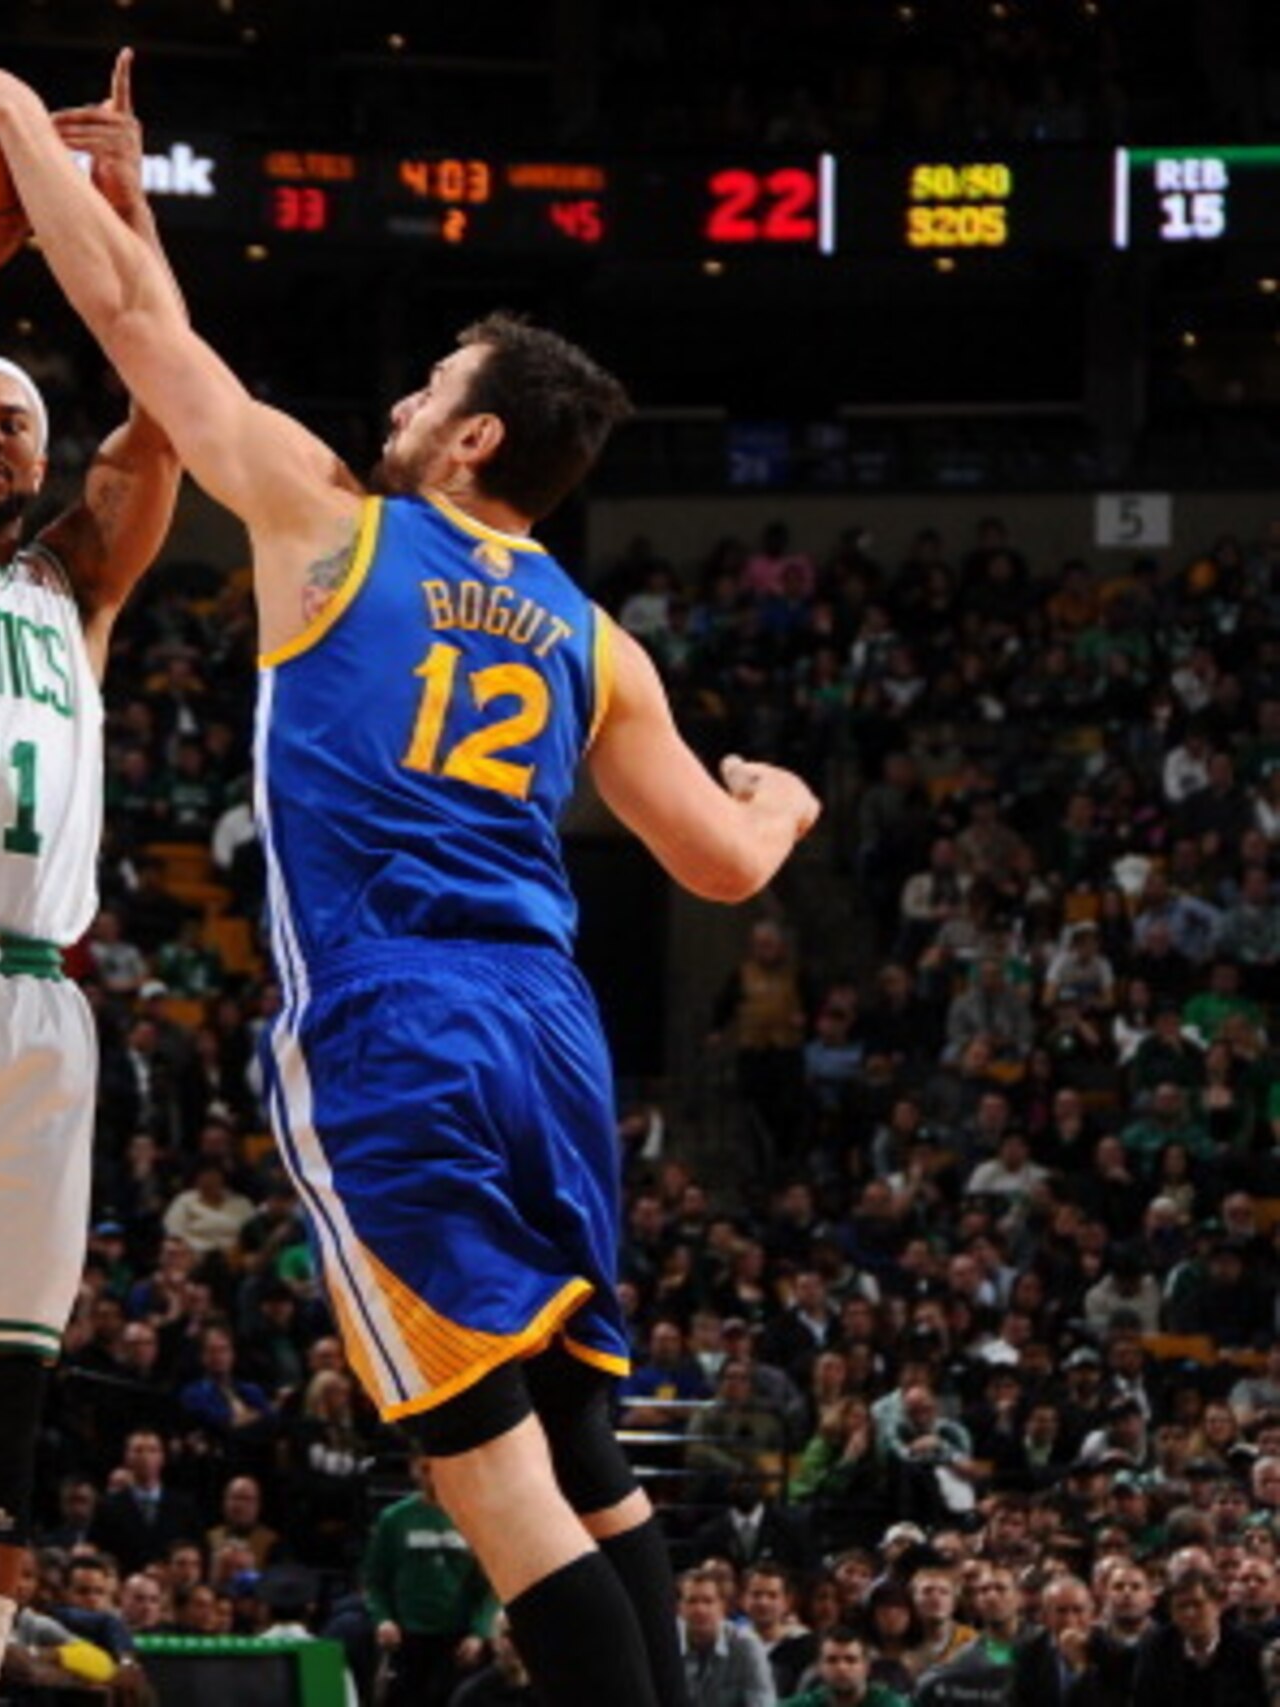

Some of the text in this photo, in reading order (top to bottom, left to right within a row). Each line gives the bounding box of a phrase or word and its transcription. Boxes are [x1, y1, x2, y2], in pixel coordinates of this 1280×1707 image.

[1154, 158, 1229, 192] REB
[274, 186, 326, 231] 33
[441, 208, 467, 242] 2
[550, 200, 603, 242] 45
[708, 169, 817, 242] 22
[1160, 193, 1226, 239] 15
[1117, 498, 1144, 542] 5
[422, 579, 573, 657] BOGUT
[400, 641, 551, 802] 12
